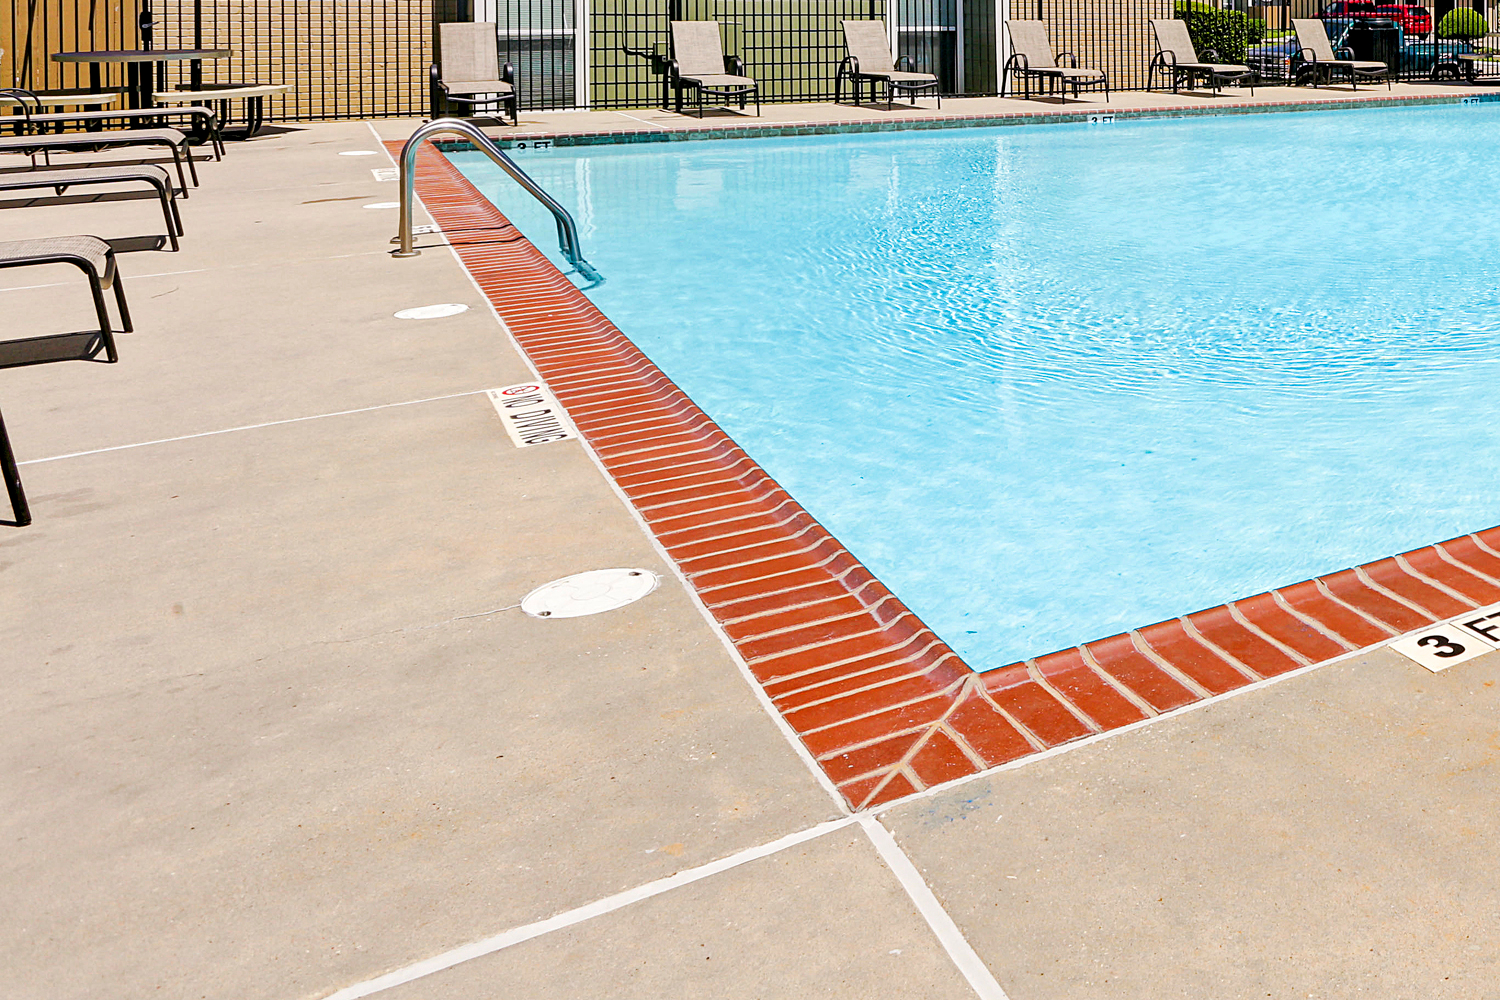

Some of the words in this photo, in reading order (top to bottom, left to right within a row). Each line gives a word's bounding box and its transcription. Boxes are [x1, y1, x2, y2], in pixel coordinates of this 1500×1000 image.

[1102, 115, 1114, 124] FT
[501, 393, 545, 408] NO
[509, 409, 568, 444] DIVING
[1416, 634, 1466, 658] 3
